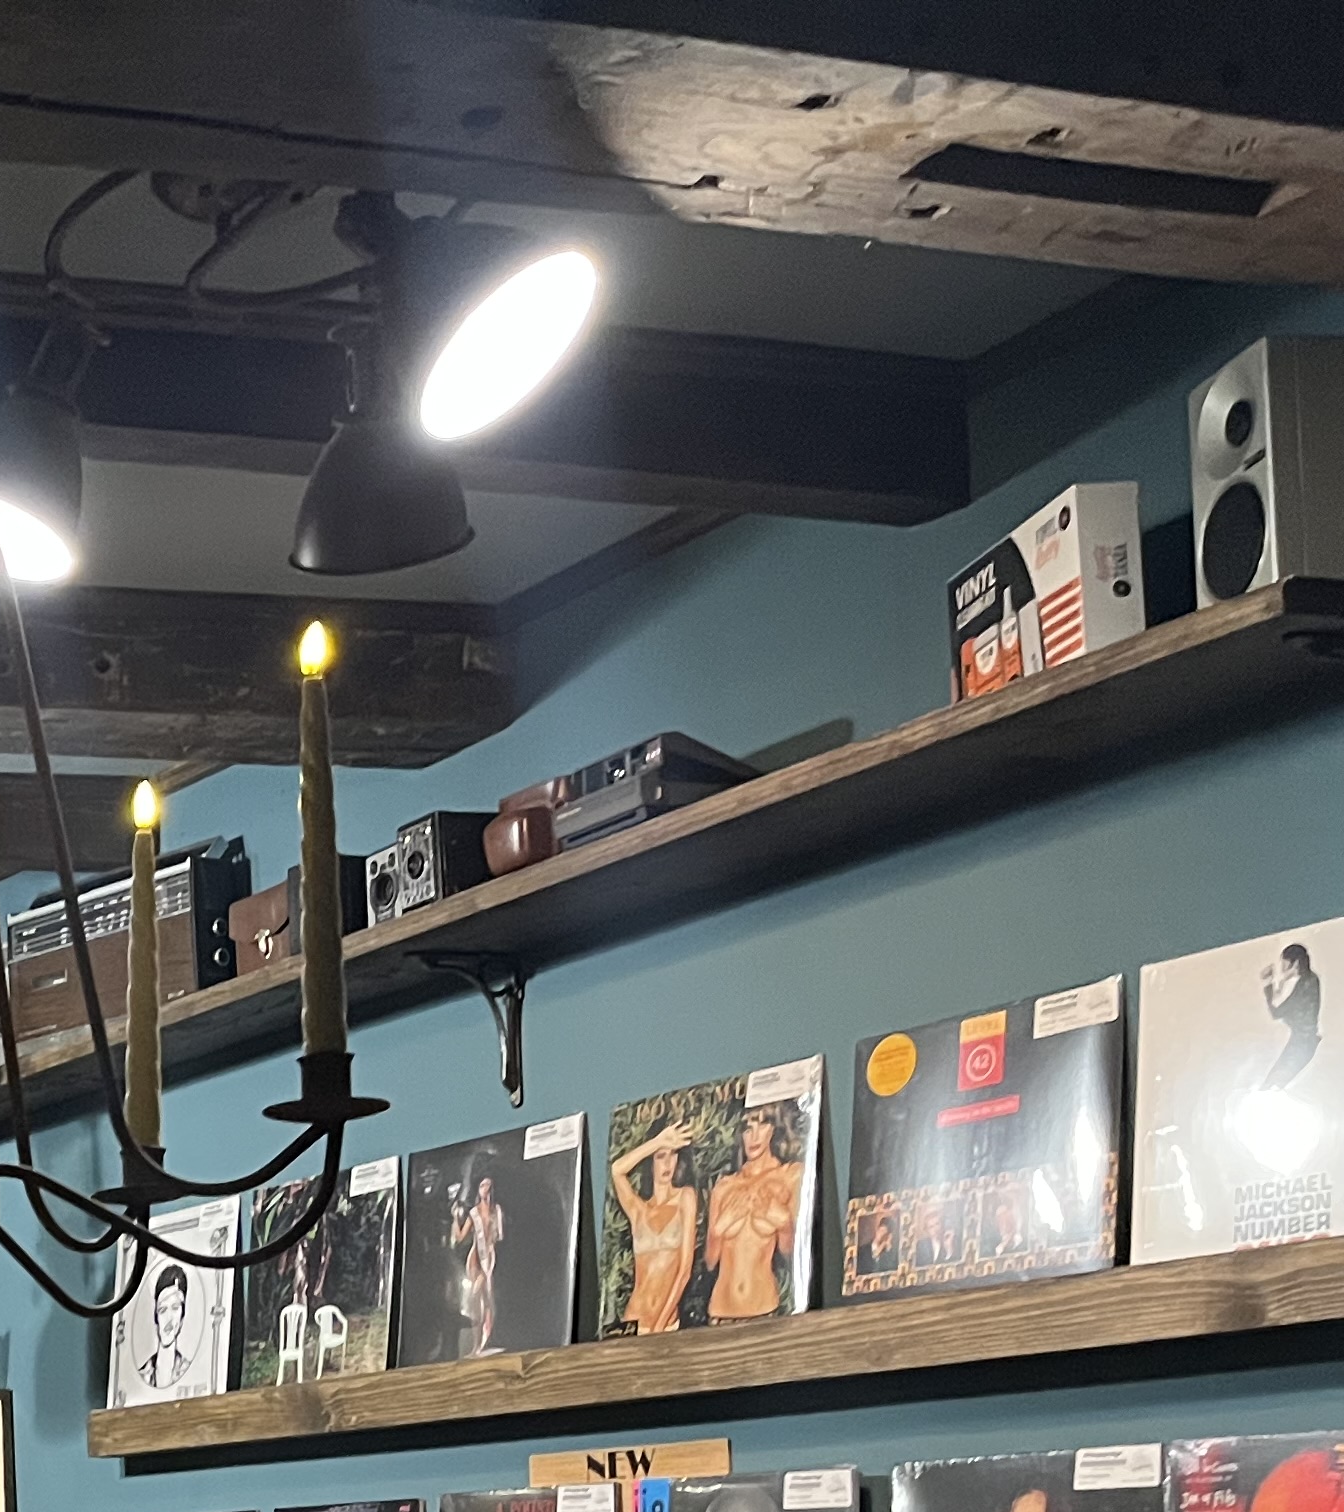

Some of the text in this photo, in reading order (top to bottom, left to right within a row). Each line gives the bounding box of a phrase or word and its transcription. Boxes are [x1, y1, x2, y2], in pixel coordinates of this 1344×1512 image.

[955, 560, 996, 610] VINYL
[972, 1052, 990, 1070] 42
[1234, 1172, 1333, 1205] MICHAEL
[1234, 1191, 1332, 1224] JACKSON
[1232, 1211, 1331, 1244] NUMBER
[585, 1448, 655, 1481] NEW
